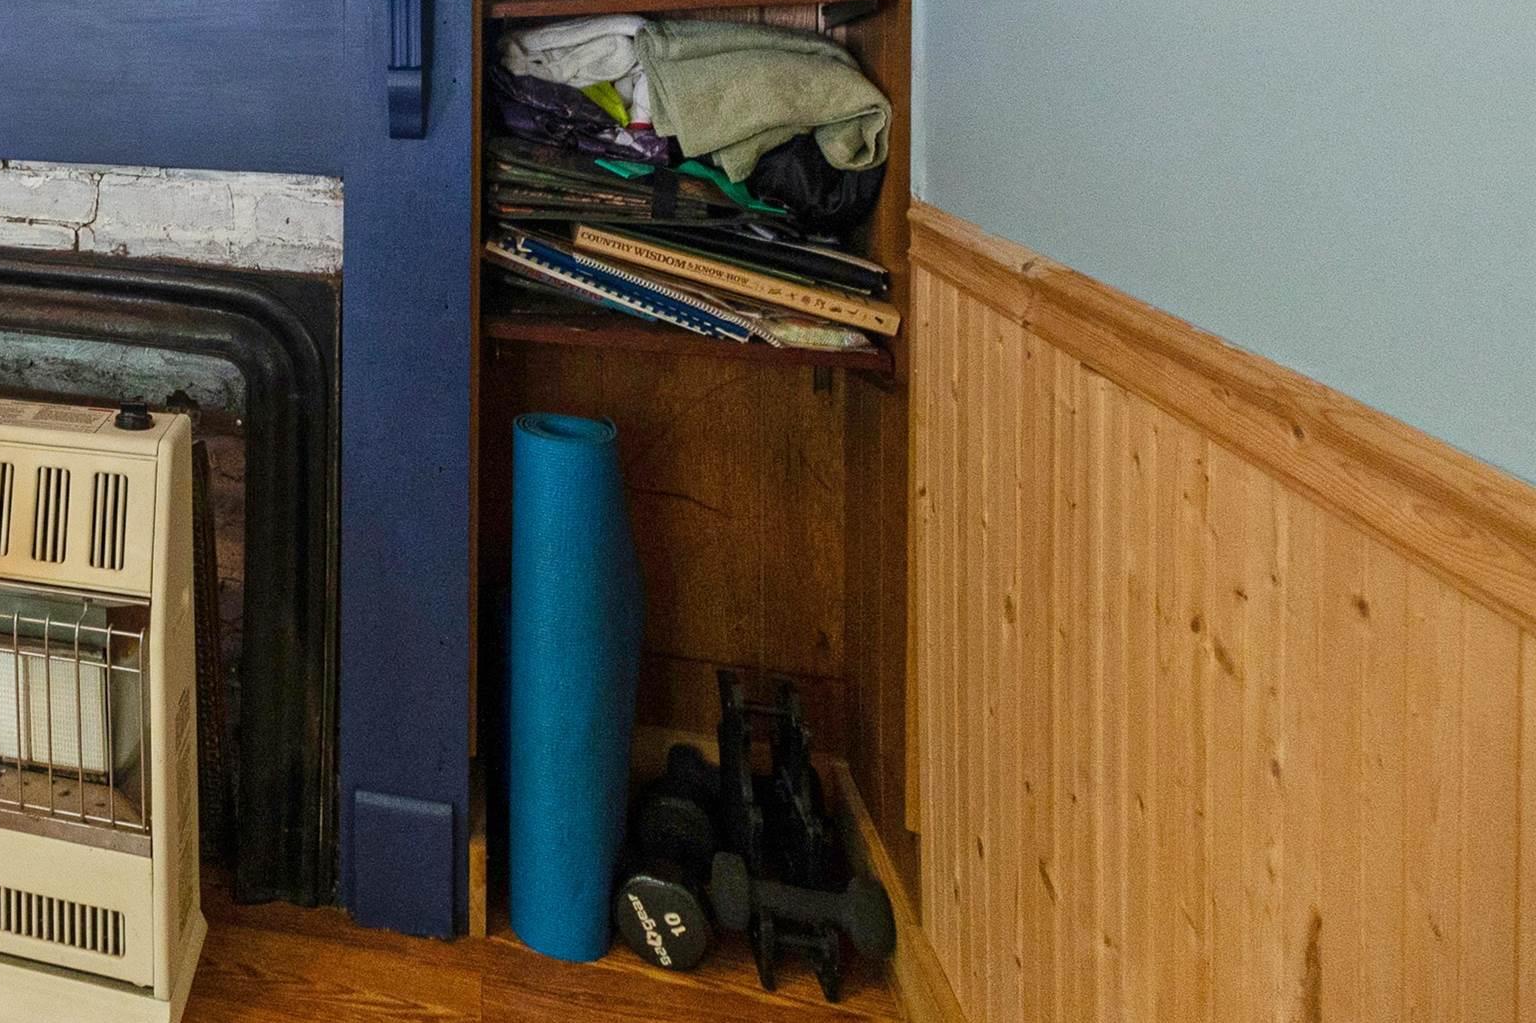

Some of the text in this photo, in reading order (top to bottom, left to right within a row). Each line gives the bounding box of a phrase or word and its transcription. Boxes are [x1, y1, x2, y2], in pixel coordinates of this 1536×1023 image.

[581, 231, 633, 253] COUNTRY
[635, 246, 686, 269] WISDOM
[664, 912, 686, 937] 10
